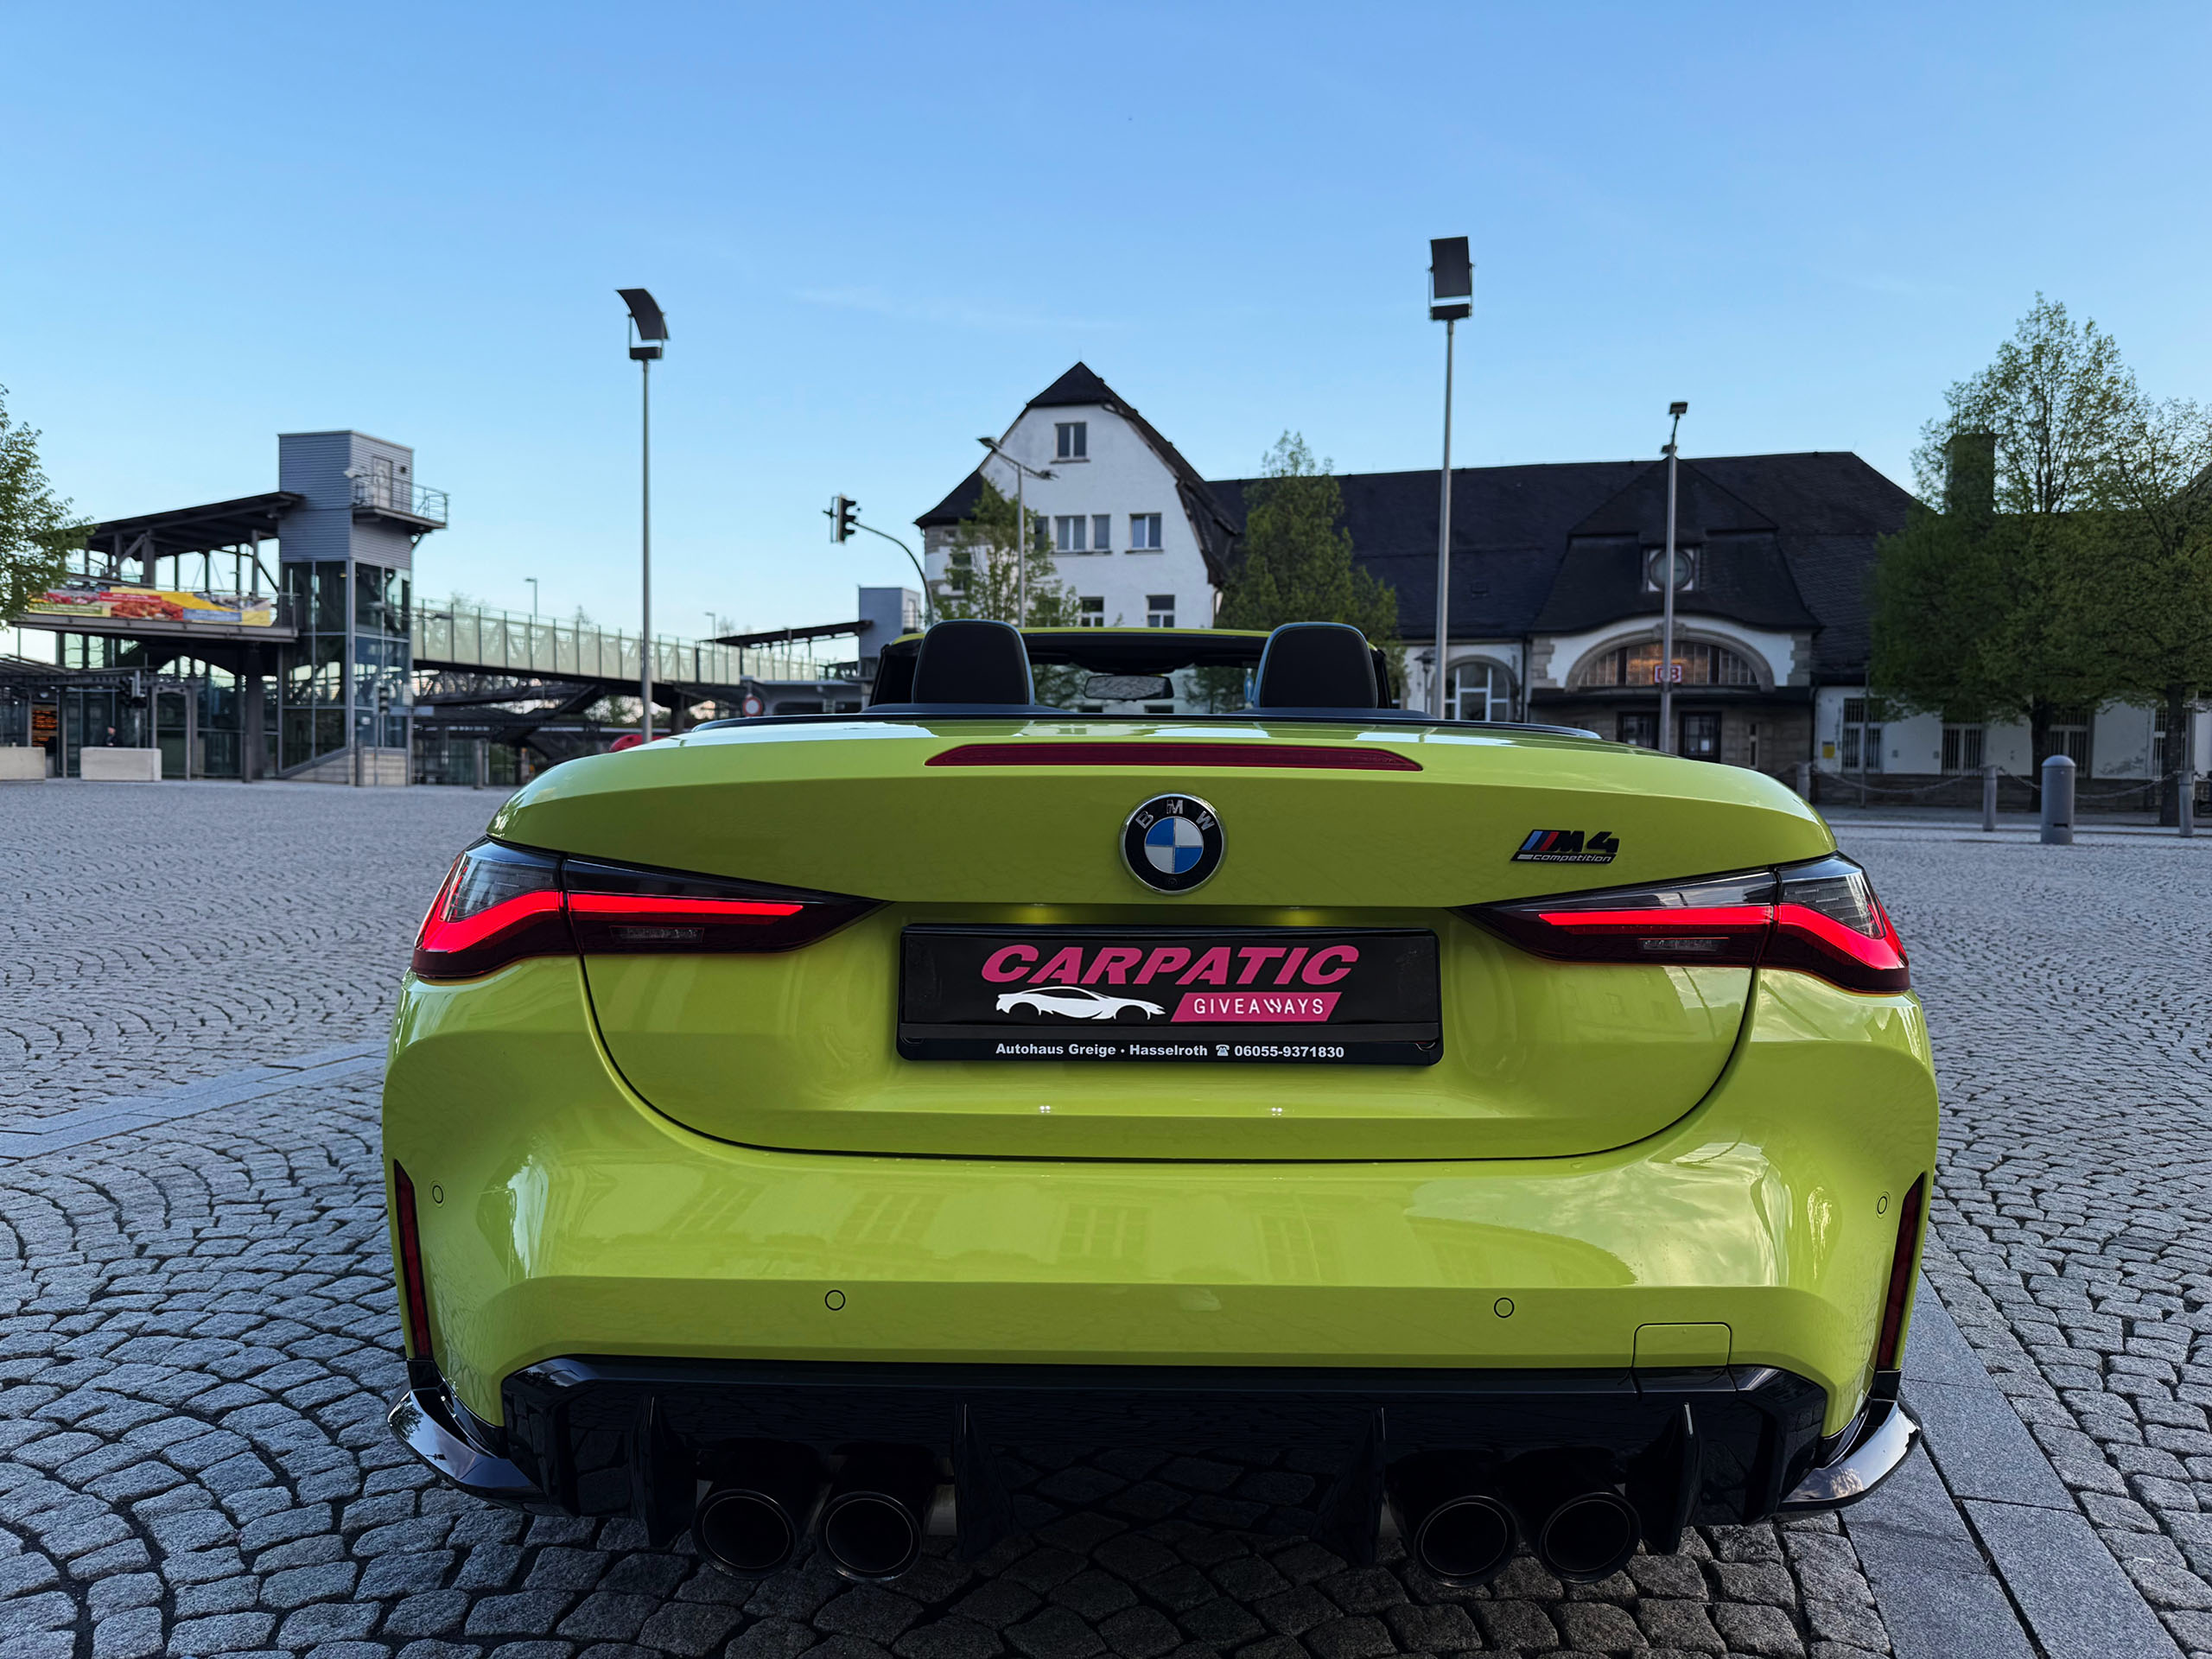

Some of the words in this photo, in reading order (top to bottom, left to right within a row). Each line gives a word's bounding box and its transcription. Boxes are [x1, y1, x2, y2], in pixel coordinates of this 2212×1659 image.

[1135, 799, 1215, 830] BMW
[981, 944, 1359, 986] CARPATIC
[1193, 997, 1324, 1016] GIVEAWAYS
[995, 1043, 1064, 1055] Autohaus
[1068, 1044, 1116, 1058] Greige
[1129, 1044, 1208, 1056] Hasselroth
[1234, 1046, 1344, 1058] 06055-9371830
